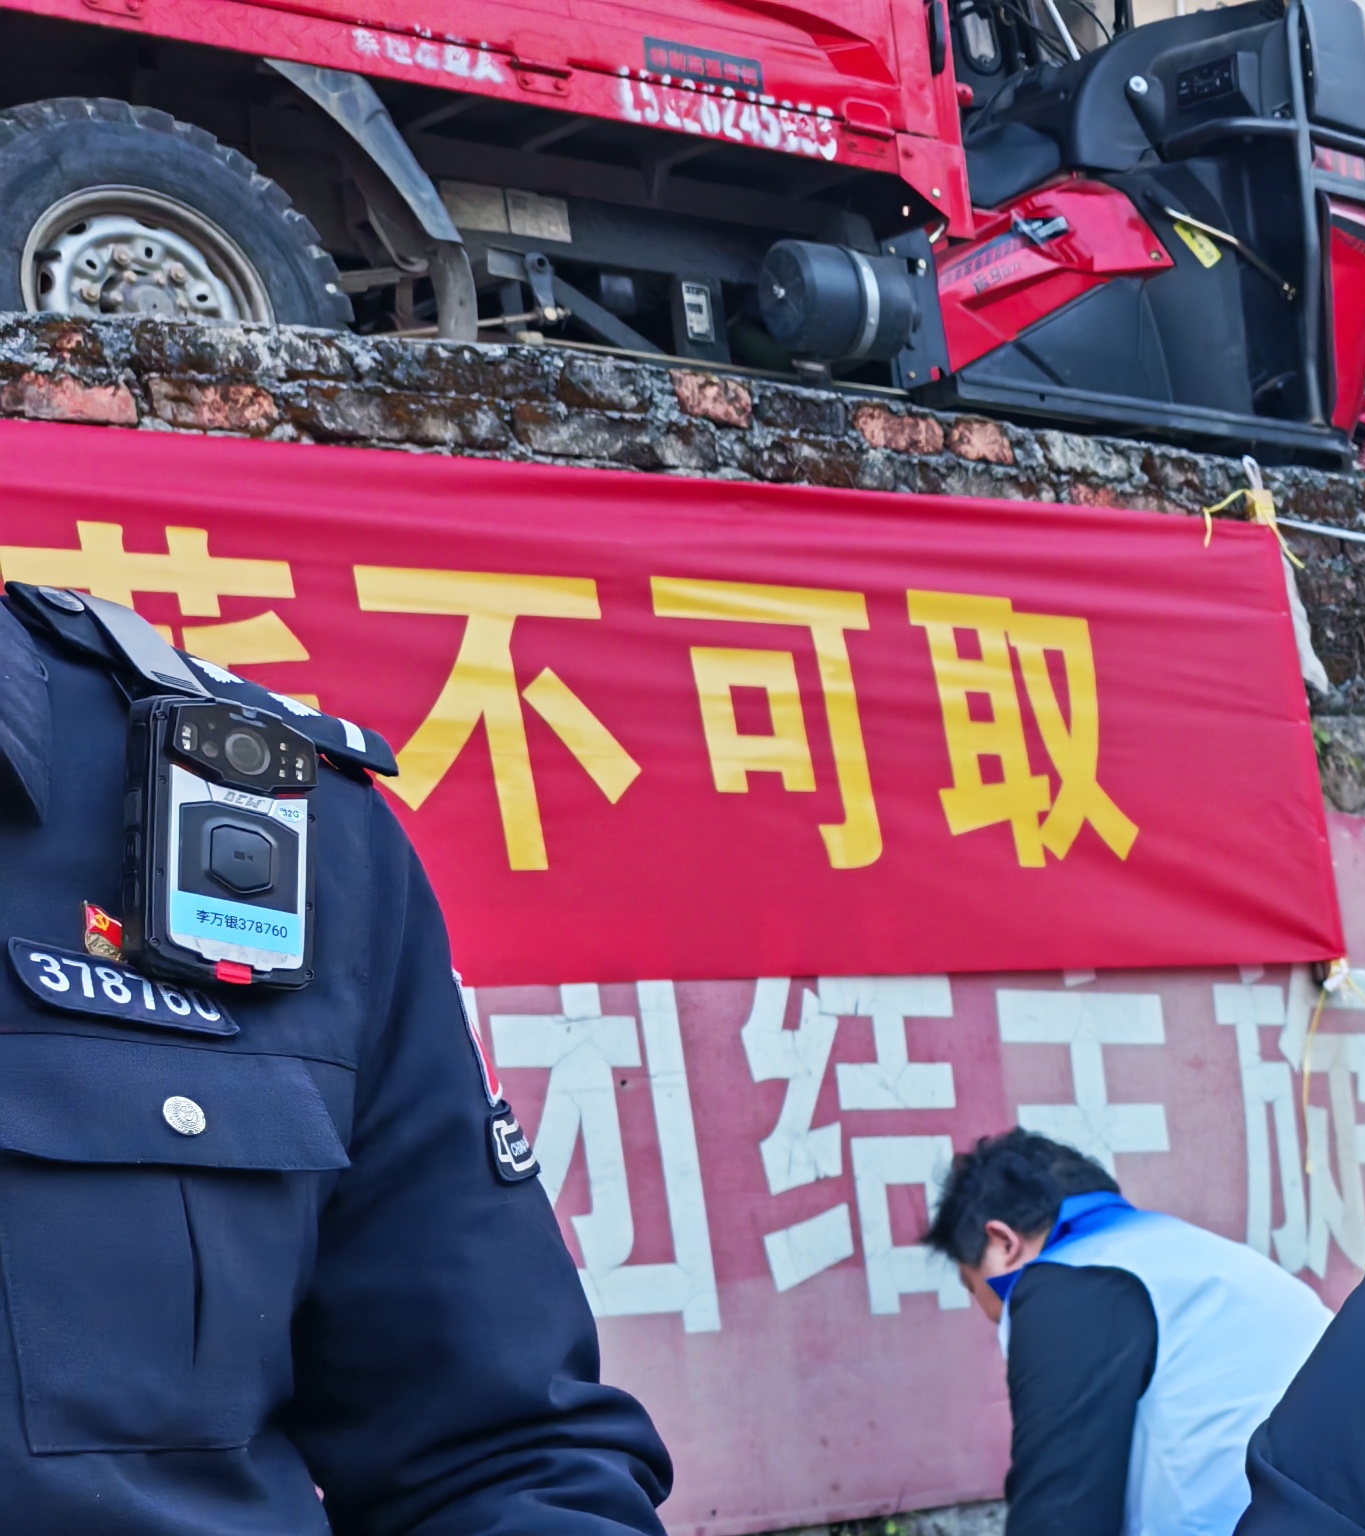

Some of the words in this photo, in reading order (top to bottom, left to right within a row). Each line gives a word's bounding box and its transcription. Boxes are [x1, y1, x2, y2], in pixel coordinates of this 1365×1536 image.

[196, 909, 288, 939] 李万银378760
[30, 951, 222, 1021] 378760
